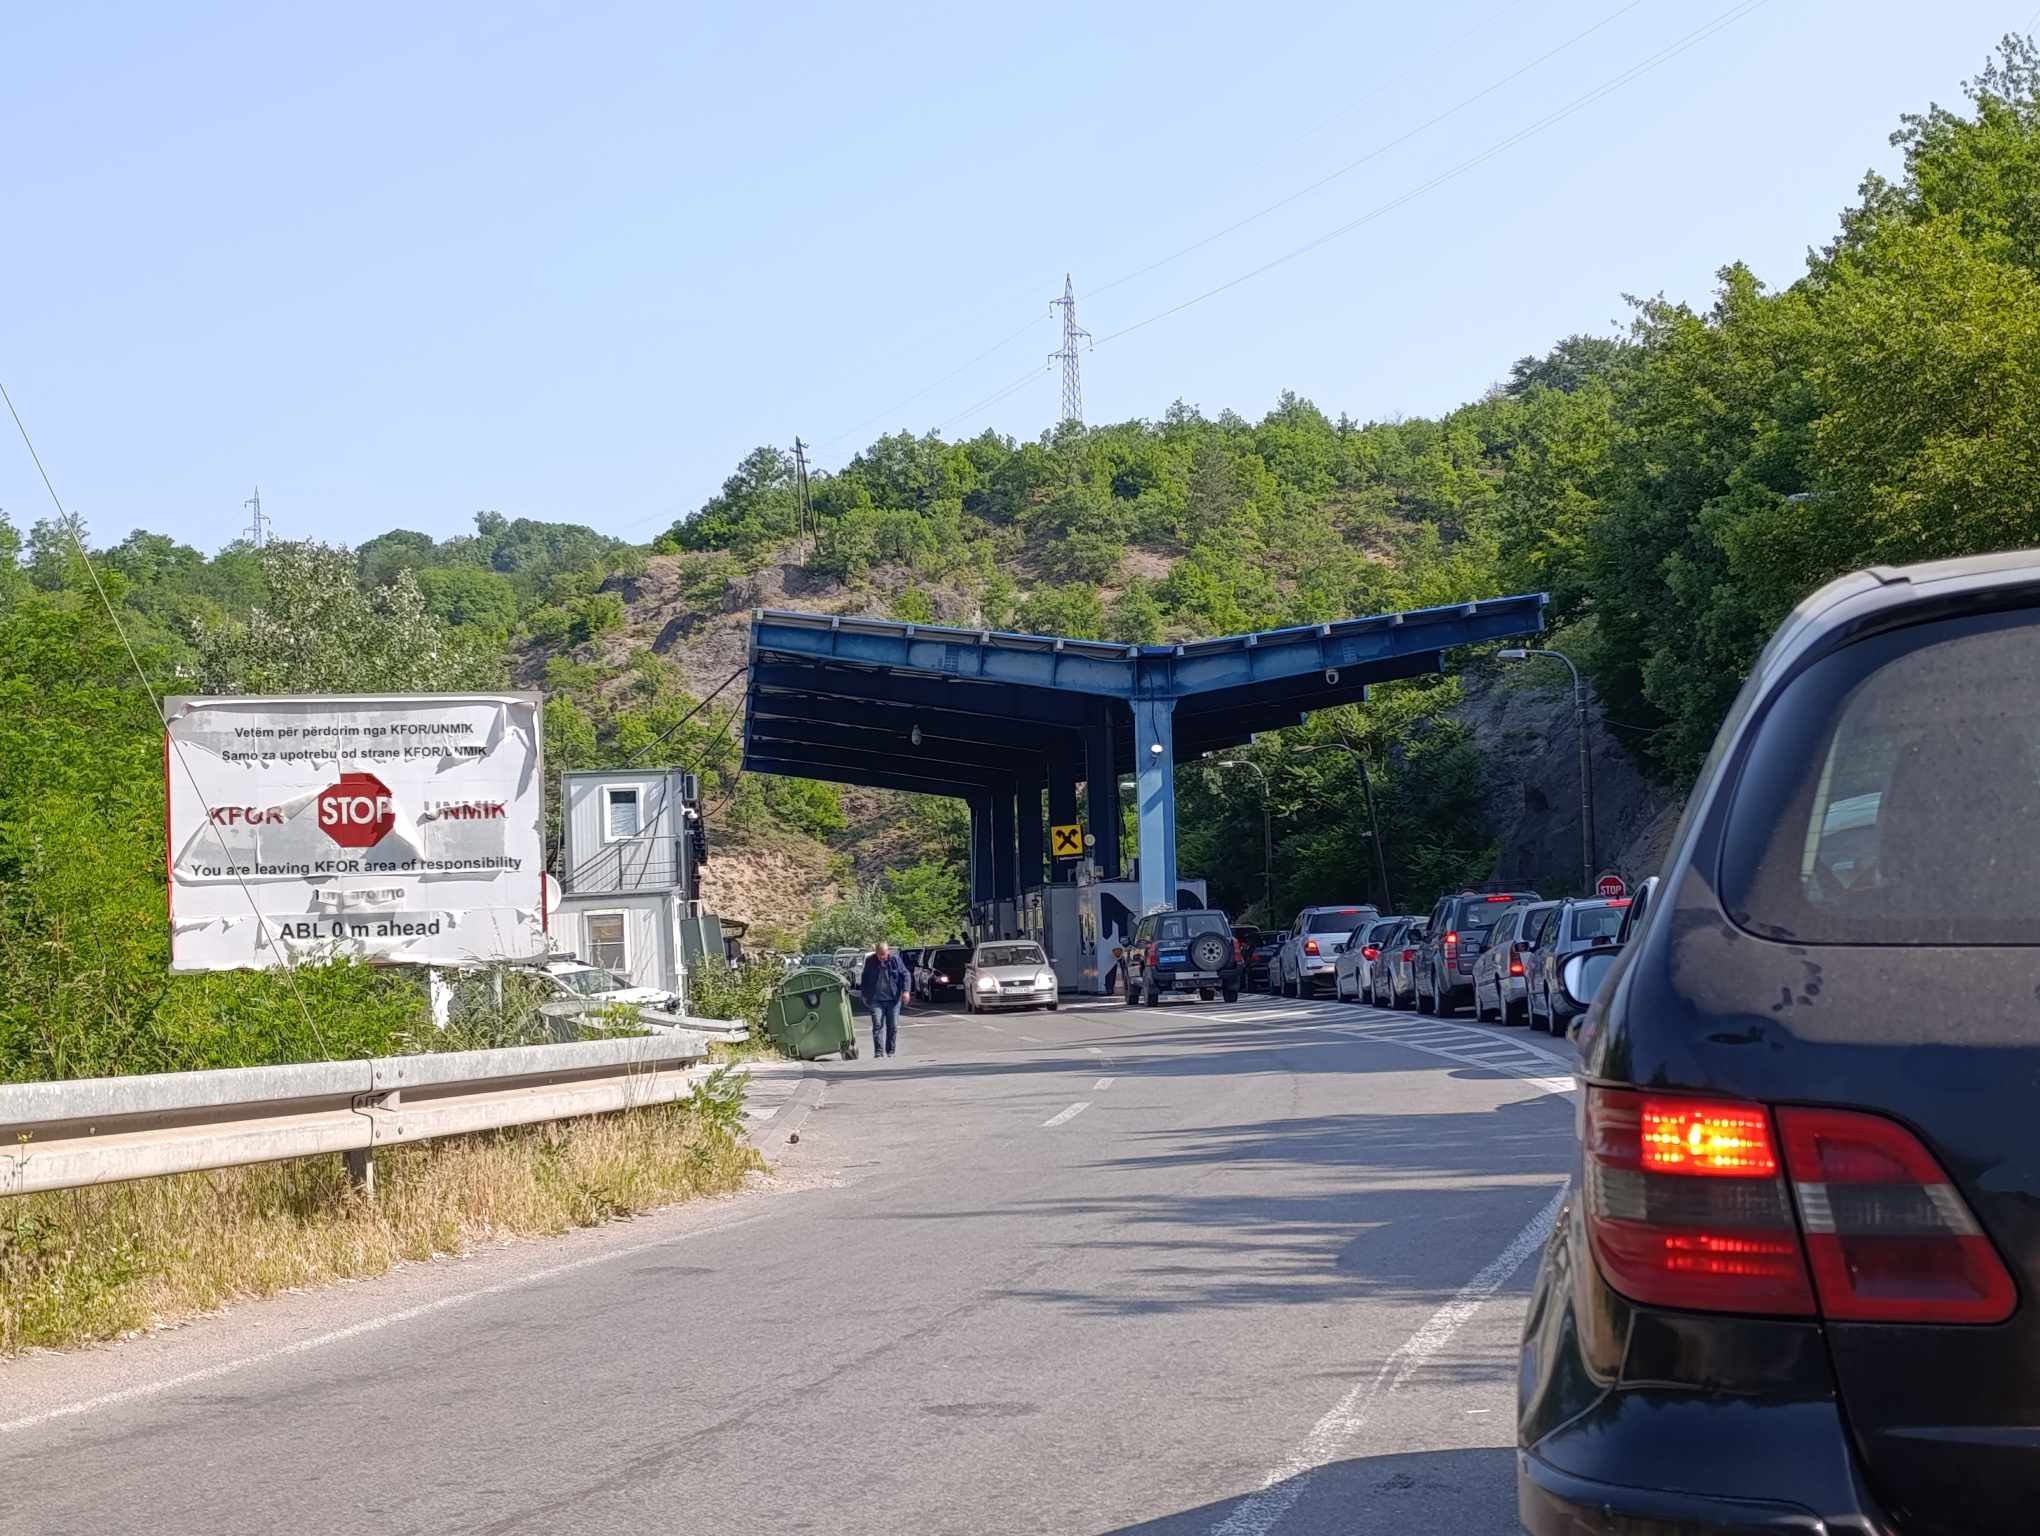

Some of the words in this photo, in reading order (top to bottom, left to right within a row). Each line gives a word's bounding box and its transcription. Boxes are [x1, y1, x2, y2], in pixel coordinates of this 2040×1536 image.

[235, 727, 274, 738] Vetëm
[303, 725, 360, 739] përdorim
[363, 727, 386, 738] nga
[390, 723, 474, 735] KFOR/UNMIK
[222, 750, 258, 761] Samo
[262, 752, 276, 760] za
[280, 748, 336, 761] upotrebu
[341, 748, 357, 759] od
[361, 748, 400, 759] strane
[209, 806, 284, 825] KFOR
[321, 796, 394, 825] STOP
[191, 864, 221, 876] You
[226, 865, 250, 875] are
[255, 862, 310, 875] leaving
[315, 860, 360, 873] KFOR
[364, 861, 397, 872] area
[401, 858, 416, 871] of
[420, 856, 522, 870] responsibility
[1600, 885, 1622, 895] STOP
[280, 922, 325, 939] ABL
[332, 921, 343, 938] 0
[351, 923, 369, 937] m
[377, 918, 440, 937] ahead
